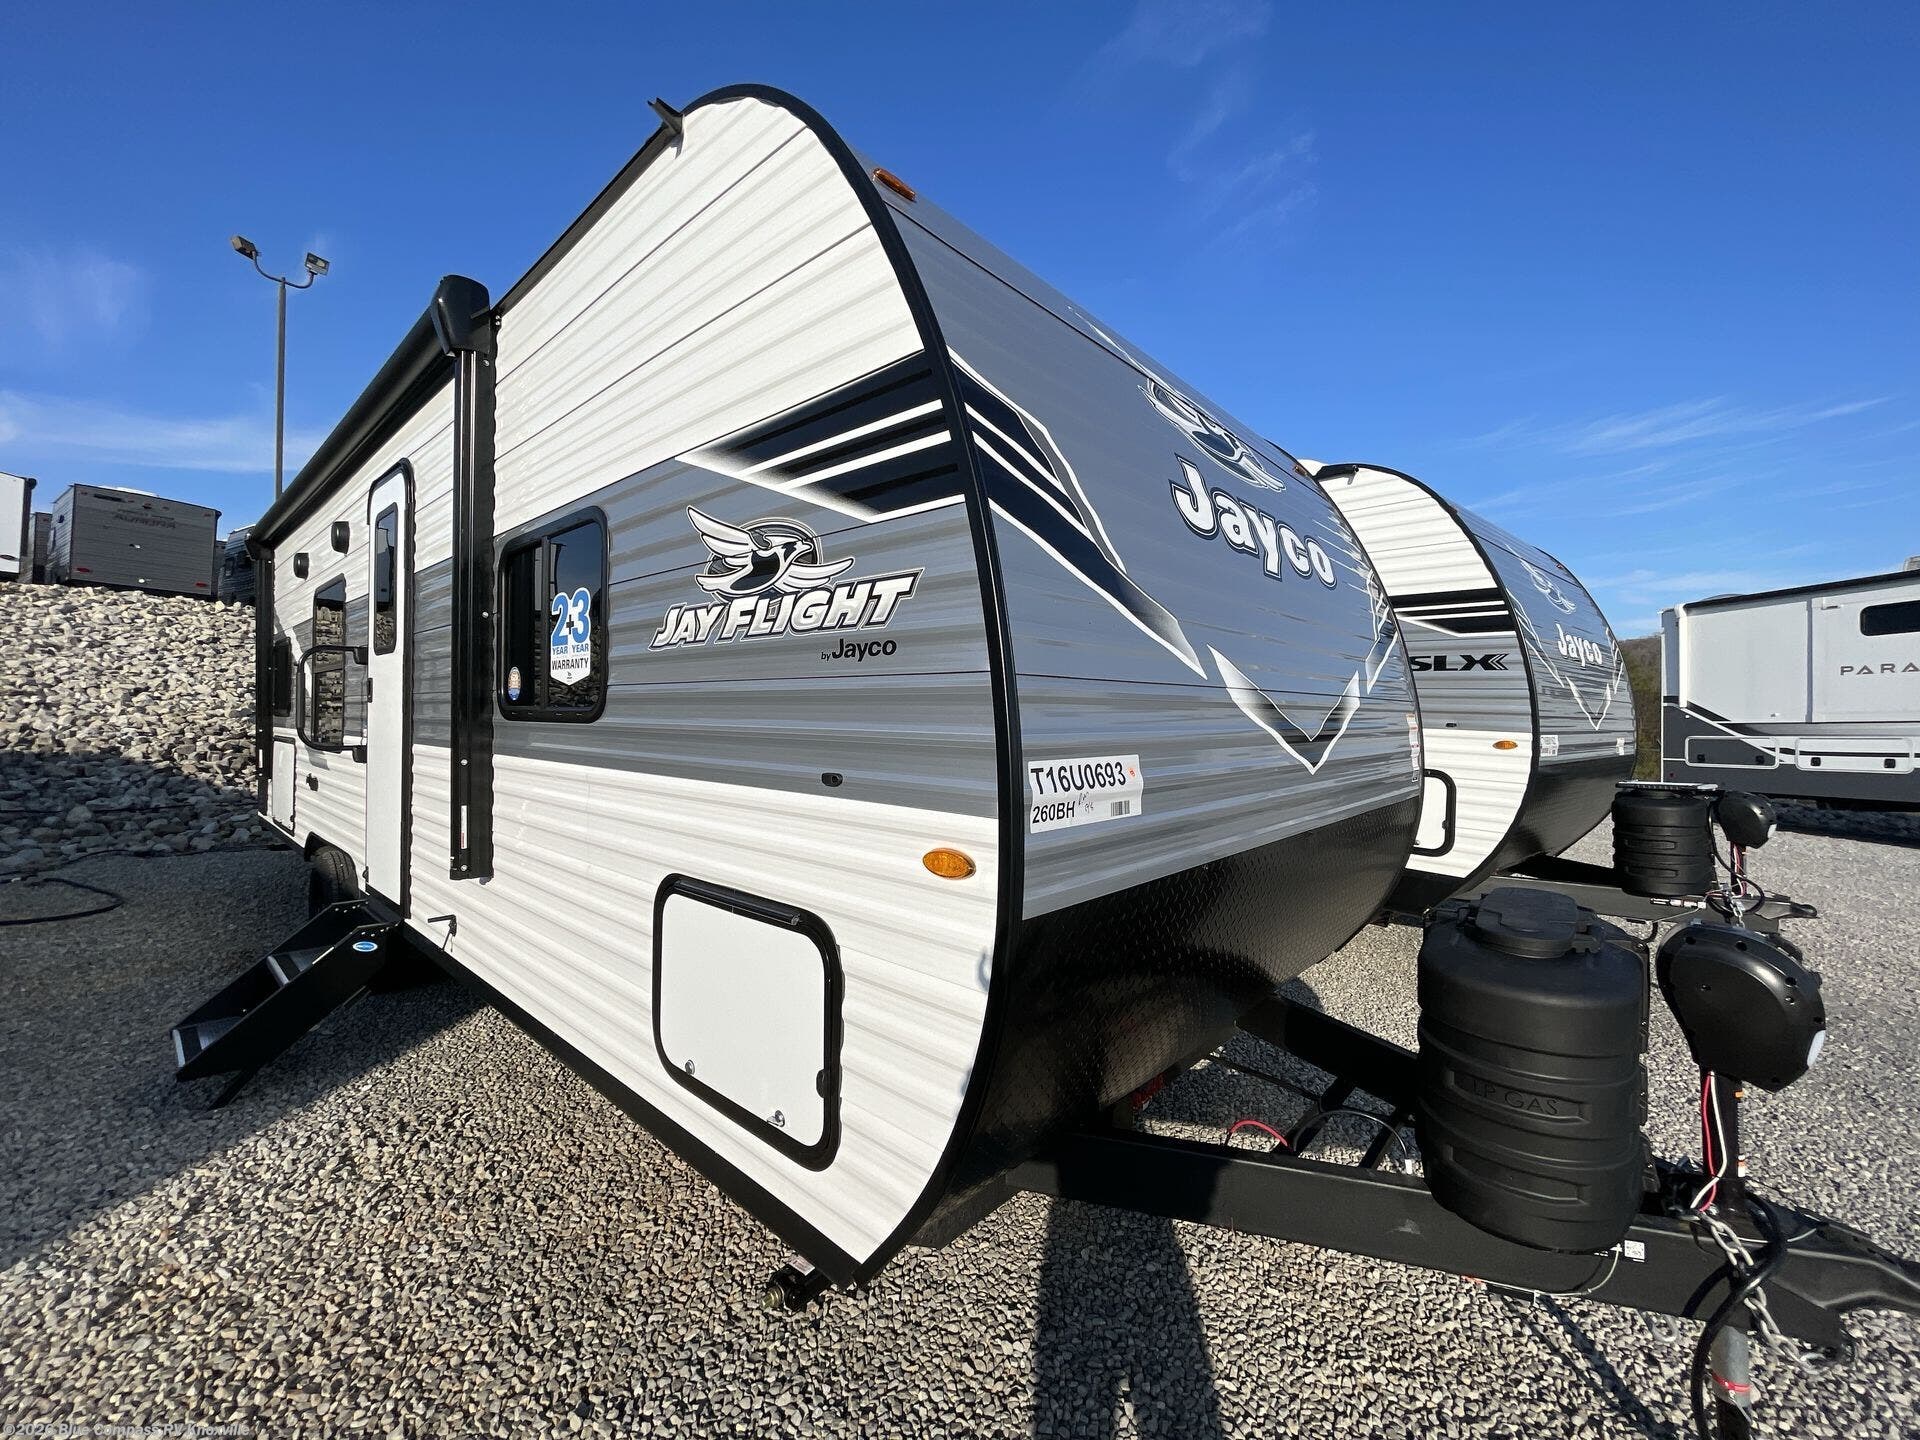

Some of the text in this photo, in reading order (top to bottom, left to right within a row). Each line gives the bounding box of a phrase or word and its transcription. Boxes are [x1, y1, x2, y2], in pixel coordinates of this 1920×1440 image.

[1168, 453, 1337, 590] Jayco
[650, 569, 923, 649] JAY FLIGHT
[552, 643, 589, 656] YEAR YEAR
[821, 638, 898, 662] by Jayco
[1556, 623, 1603, 667] Jayco
[551, 657, 589, 671] WARRANTY
[1410, 653, 1509, 672] SLX
[1840, 662, 1920, 676] PARA
[1030, 761, 1127, 795] T16U0693
[1032, 801, 1076, 824] 260BH
[1504, 1090, 1558, 1116] GAS
